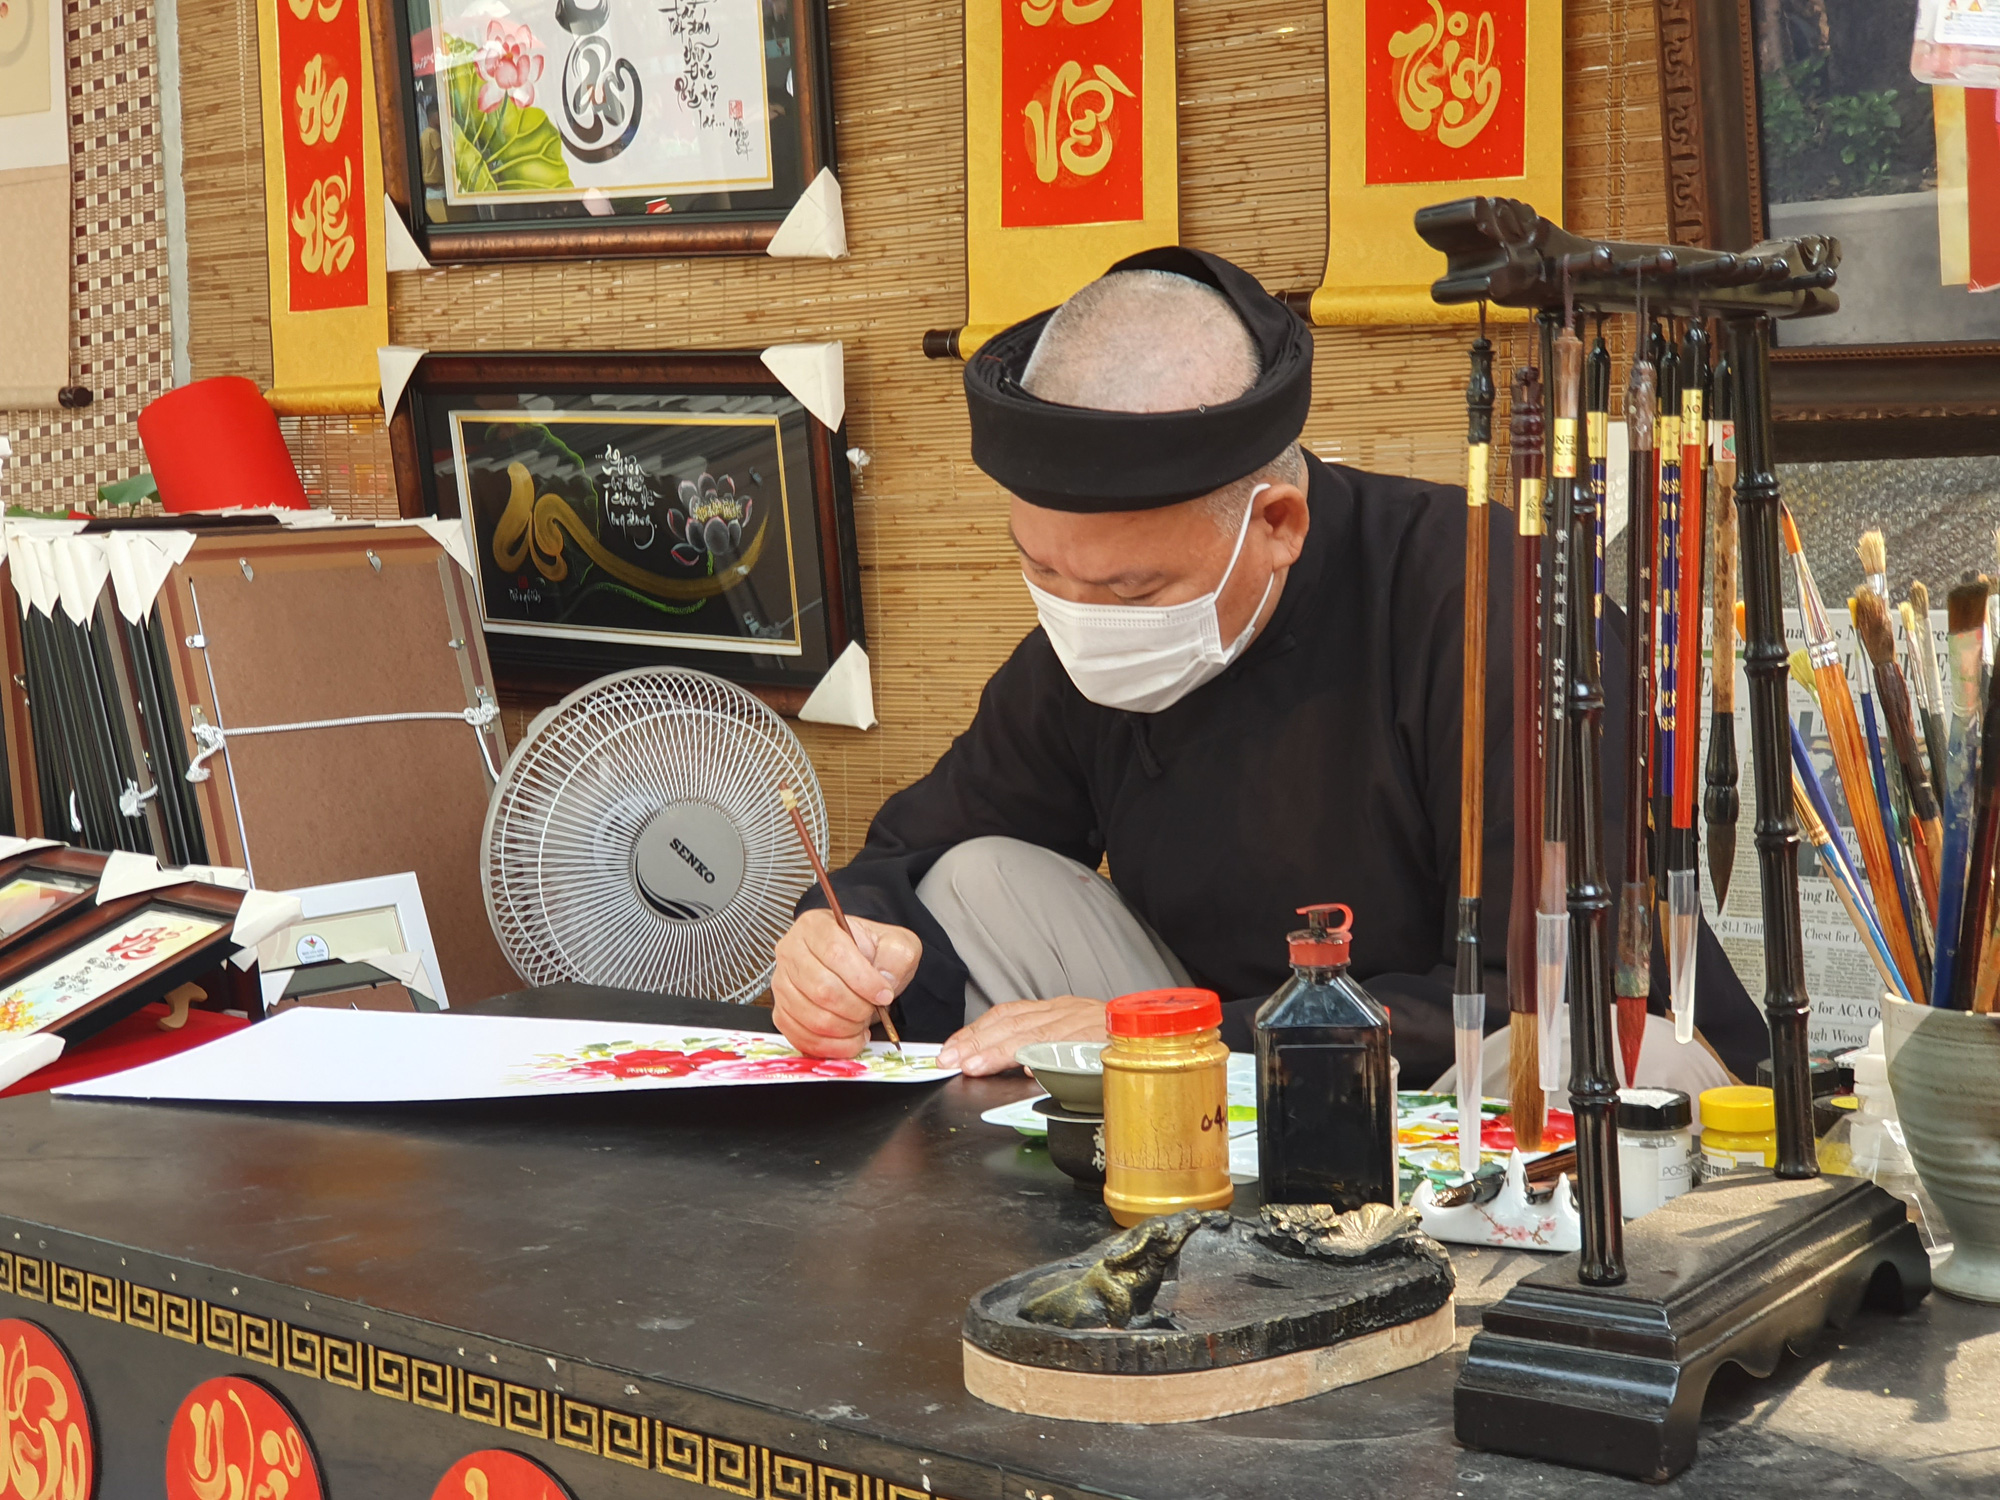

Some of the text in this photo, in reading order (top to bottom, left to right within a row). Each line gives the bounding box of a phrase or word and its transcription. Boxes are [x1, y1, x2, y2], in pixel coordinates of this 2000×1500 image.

[669, 837, 716, 884] SENKO
[1804, 927, 1832, 941] Chest
[1835, 930, 1850, 943] for
[1818, 1000, 1835, 1015] for
[1837, 1003, 1864, 1018] ACA
[1831, 1028, 1864, 1045] Woos
